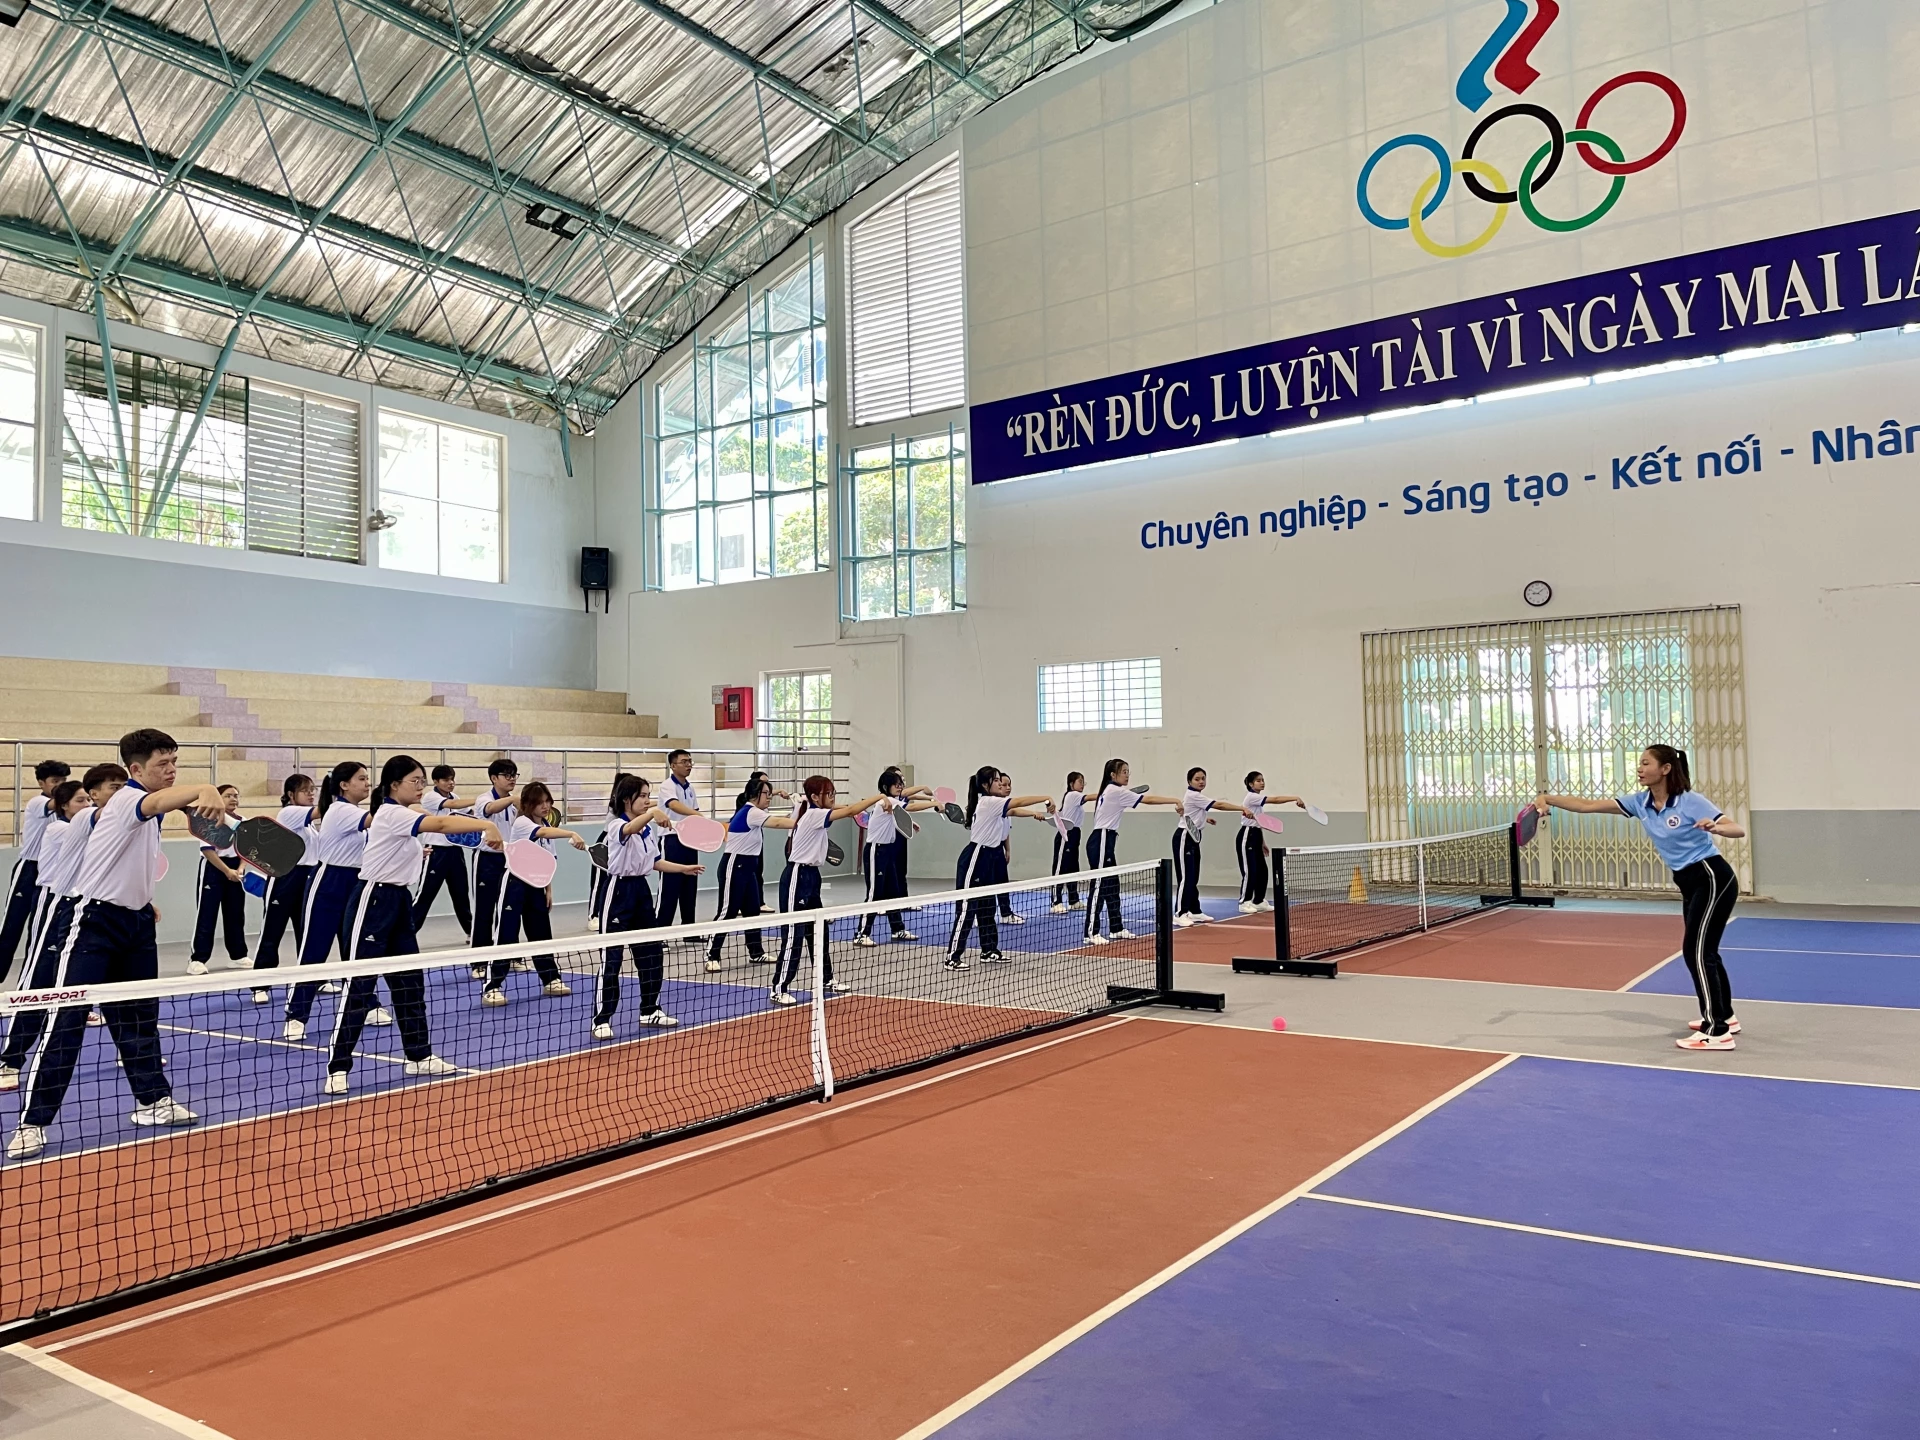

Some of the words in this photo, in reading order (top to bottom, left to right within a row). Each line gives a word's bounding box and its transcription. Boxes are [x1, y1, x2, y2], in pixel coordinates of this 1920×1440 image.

[1006, 394, 1096, 457] “RÈN
[1105, 375, 1201, 442] ĐỨC,
[1210, 346, 1360, 422] LUYỆN
[1371, 318, 1458, 392] TÀI
[1467, 297, 1527, 374] VÌ
[1538, 272, 1703, 363] NGÀY
[1715, 251, 1845, 331] MAI
[1140, 511, 1249, 550] Chuyên
[1259, 494, 1367, 538] nghiệp
[1403, 480, 1491, 514] Sáng
[1504, 471, 1569, 507] tạo
[1612, 445, 1682, 490] Kết
[1697, 433, 1763, 479] nối
